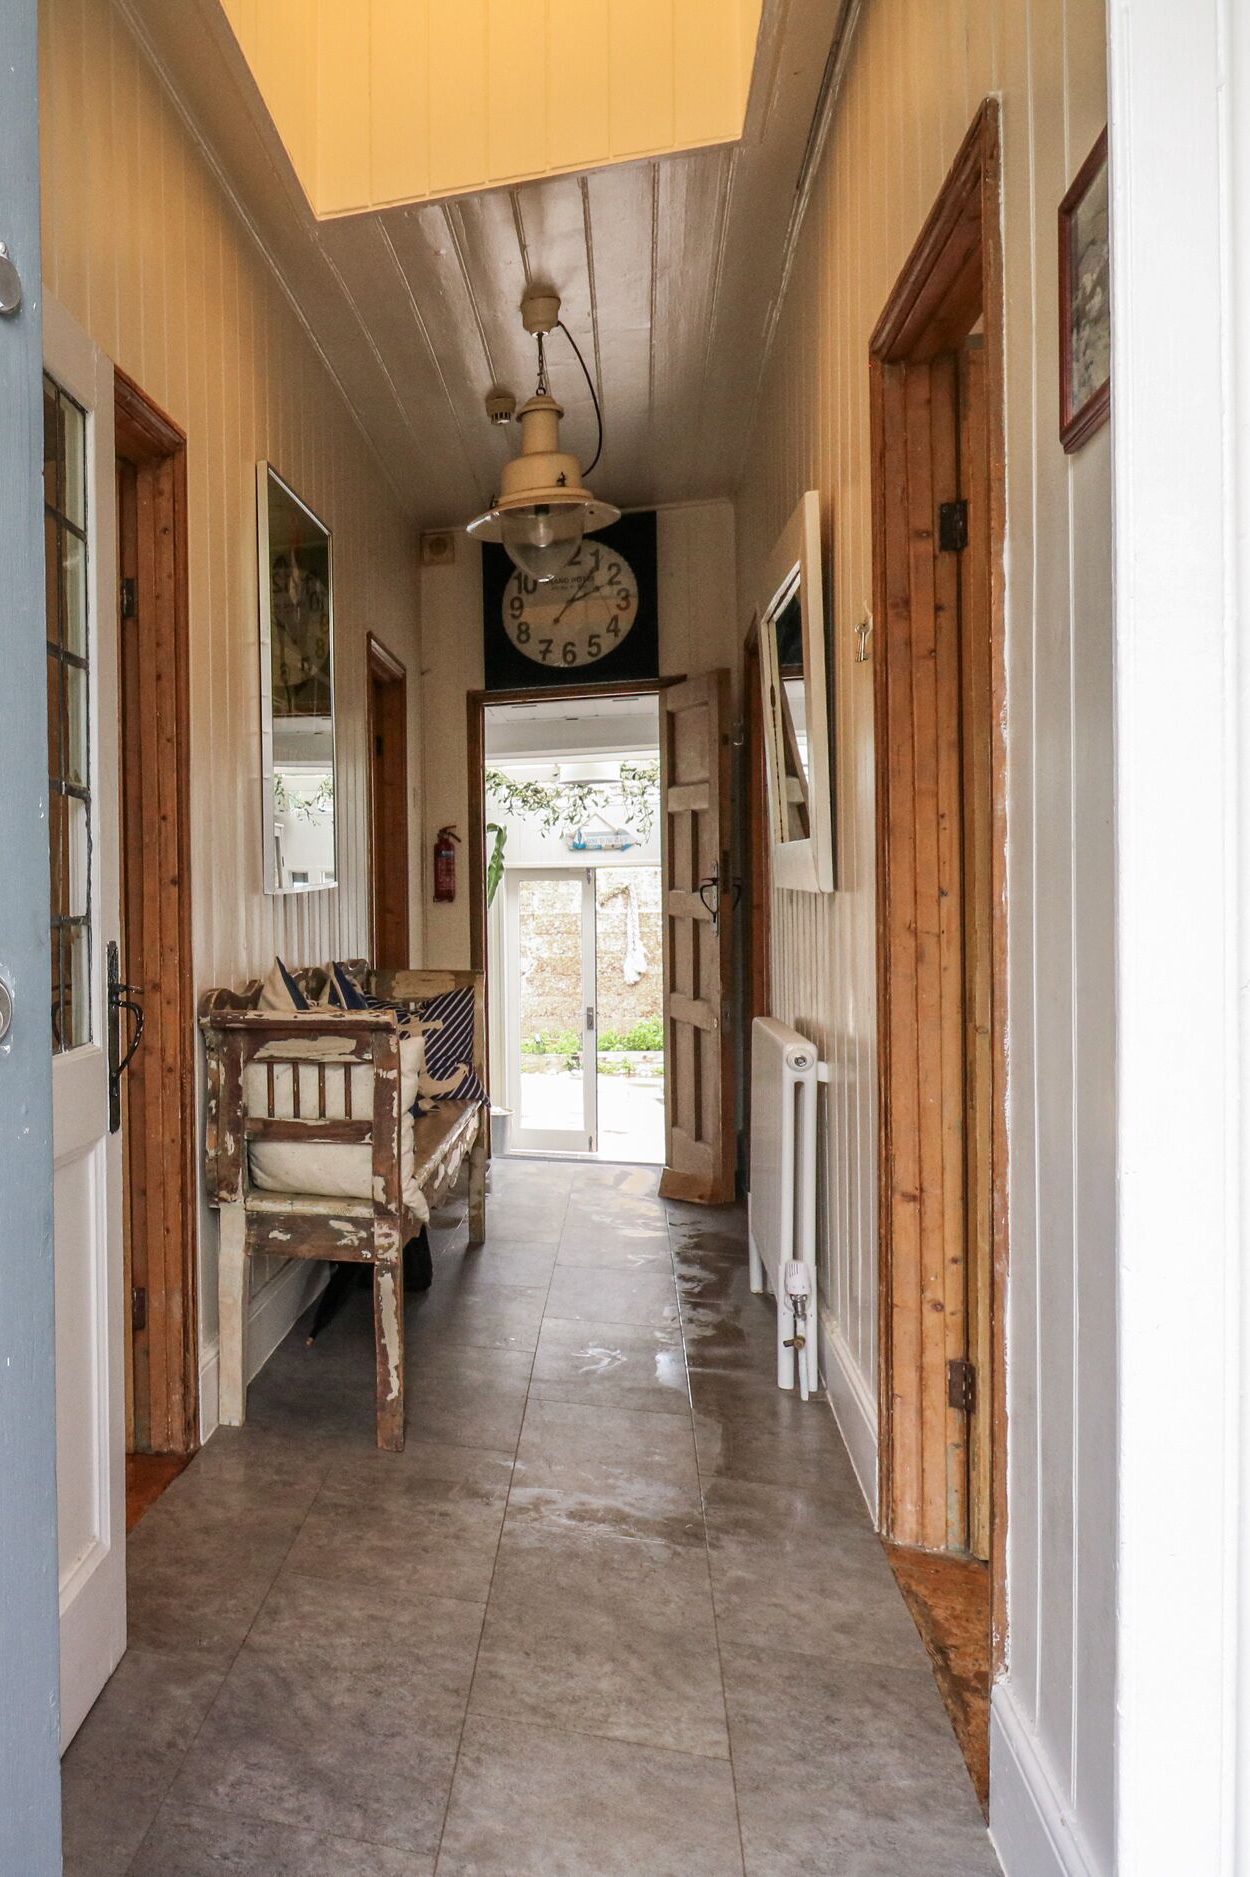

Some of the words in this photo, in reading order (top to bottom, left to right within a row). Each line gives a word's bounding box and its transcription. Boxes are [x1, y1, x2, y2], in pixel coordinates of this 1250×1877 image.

[589, 548, 602, 571] 1
[513, 572, 538, 595] 10
[607, 562, 622, 586] 2
[510, 596, 524, 619] 9
[616, 588, 631, 611] 3
[516, 621, 531, 644] 8
[606, 615, 621, 639] 4
[538, 639, 554, 662] 7
[562, 641, 577, 665] 6
[587, 634, 601, 658] 5
